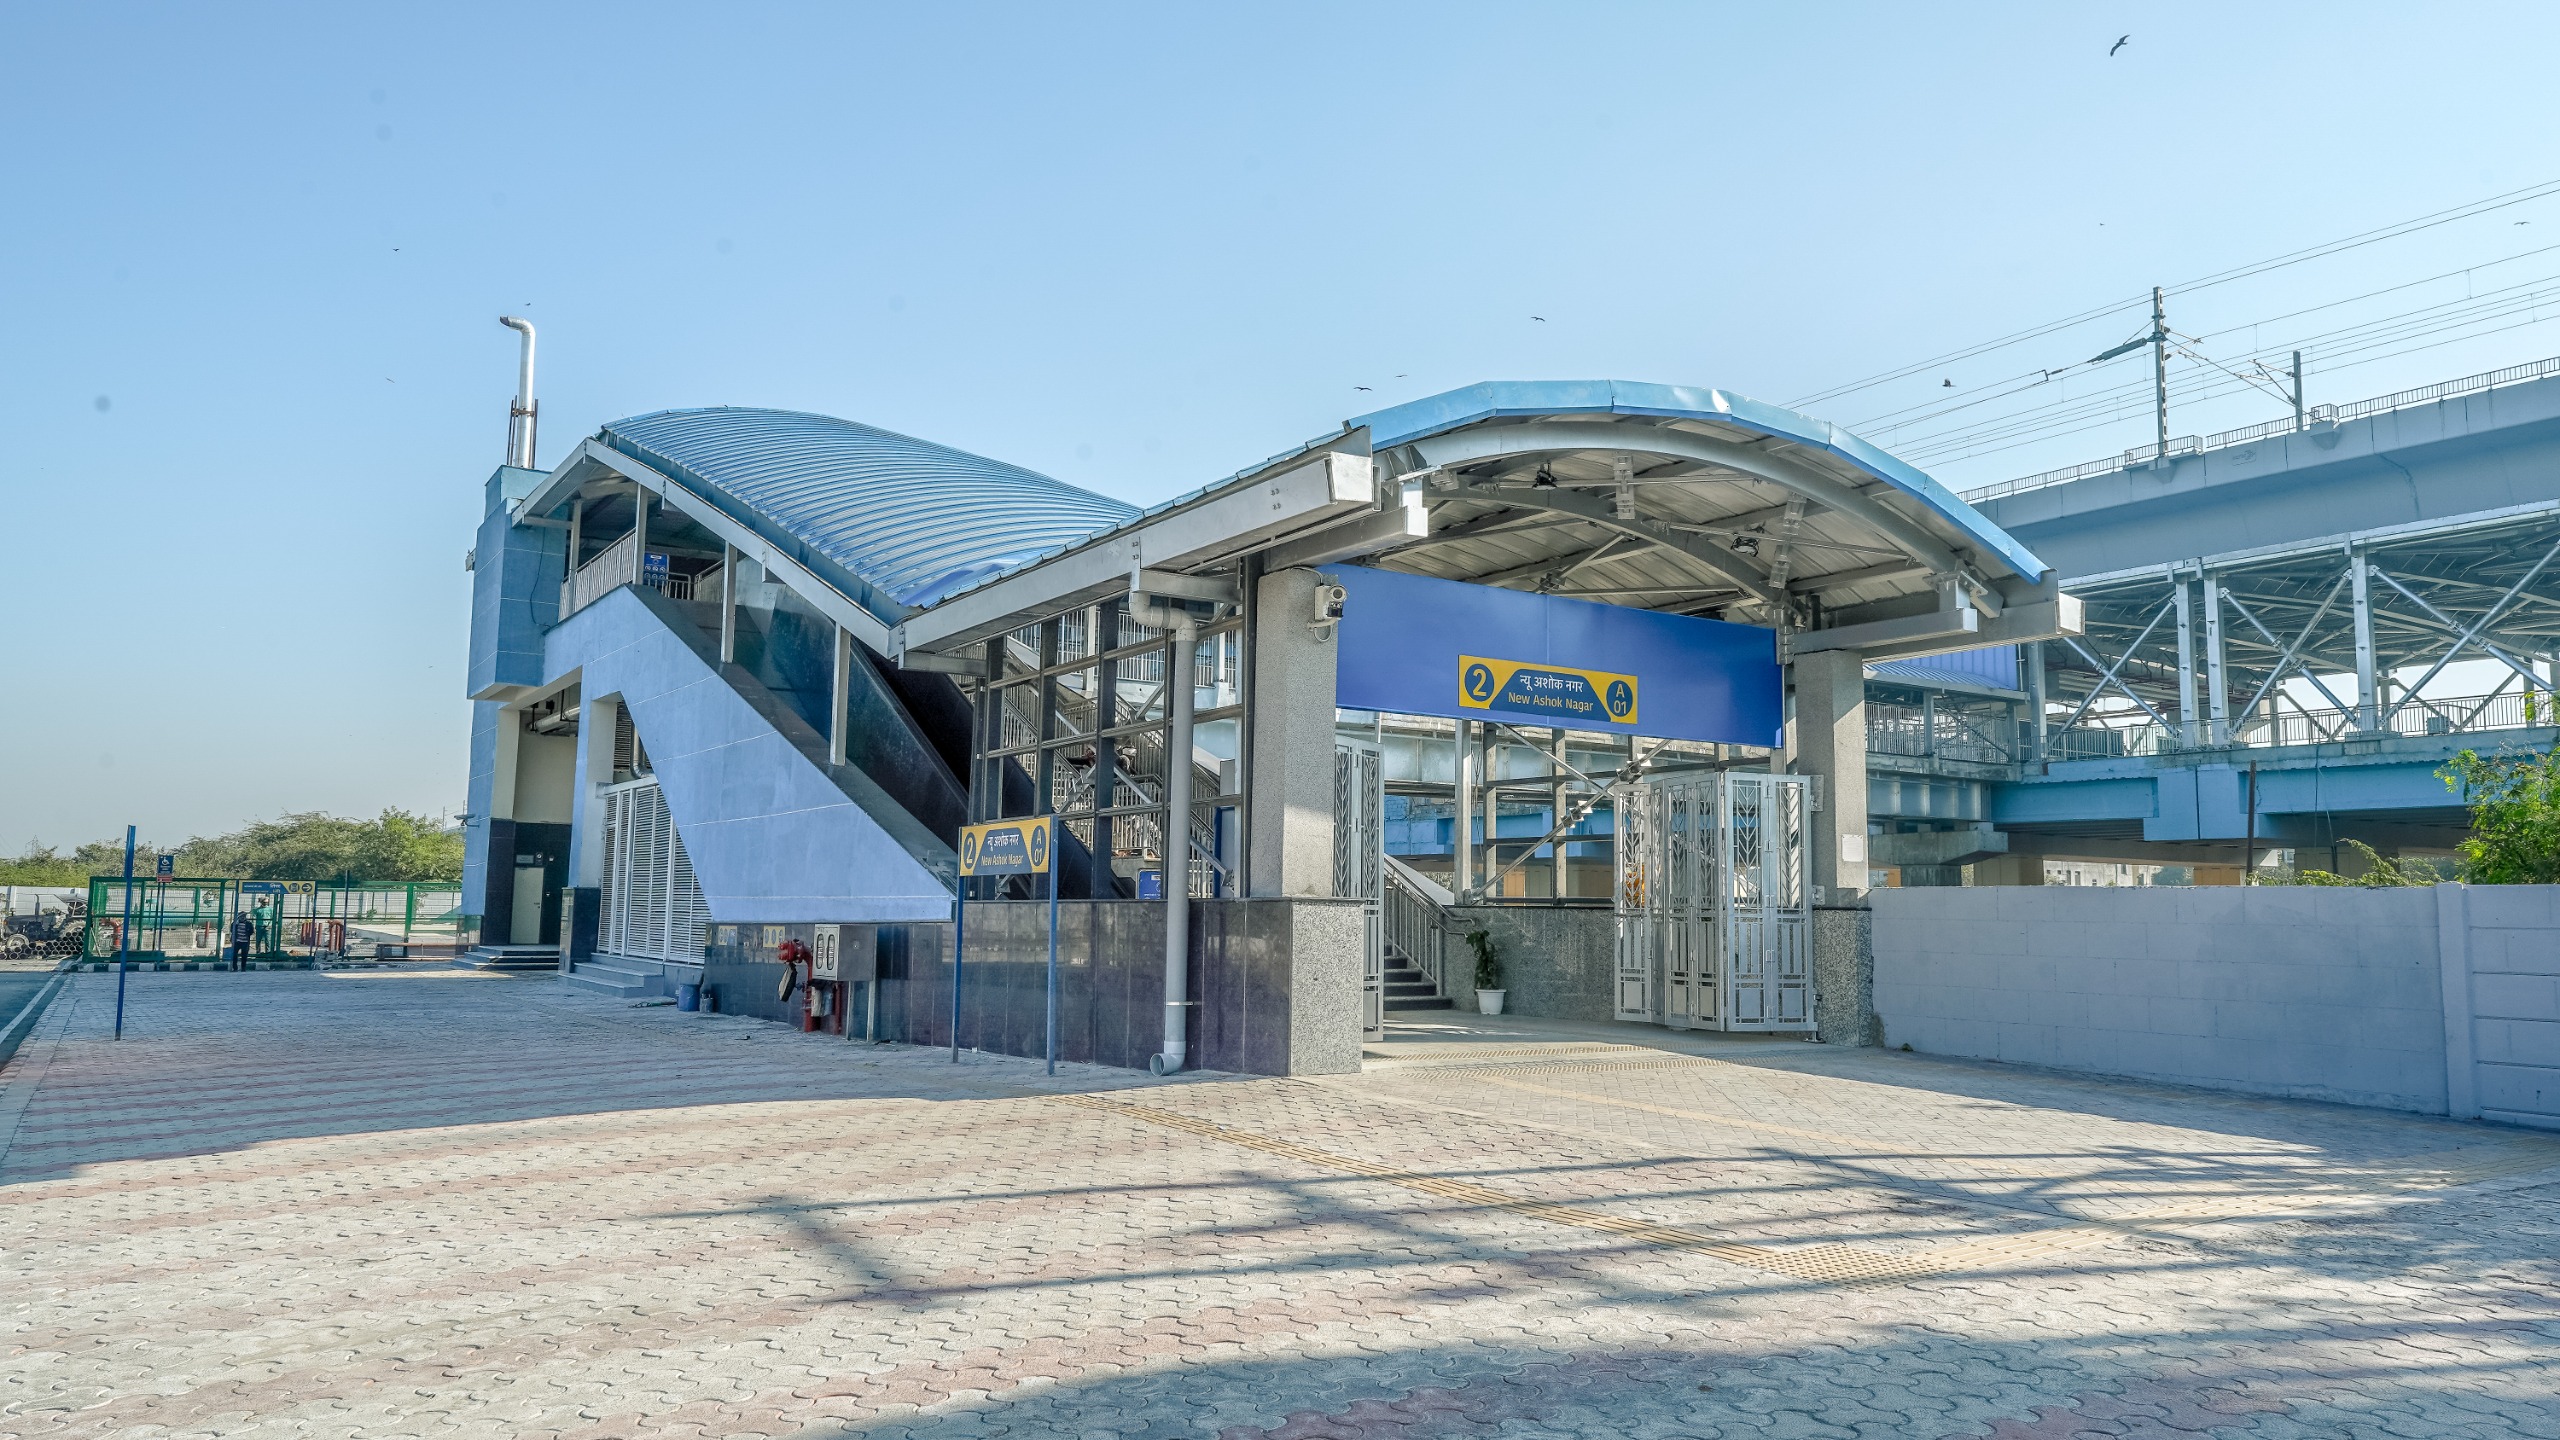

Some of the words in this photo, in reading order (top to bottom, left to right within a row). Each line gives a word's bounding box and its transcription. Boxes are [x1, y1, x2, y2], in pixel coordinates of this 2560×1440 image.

[1472, 668, 1487, 697] 2
[1520, 674, 1533, 691] न्यू
[1533, 674, 1563, 690] अशोक
[1565, 680, 1584, 692] नगर
[1615, 683, 1625, 698] A
[1508, 691, 1530, 705] New
[1533, 694, 1563, 708] Ashok
[1566, 698, 1593, 713] Nagar
[1613, 701, 1627, 715] 01
[1036, 829, 1042, 845] A
[966, 837, 973, 864] 2
[1034, 848, 1043, 863] 01
[981, 855, 992, 867] New
[992, 853, 1008, 866] Ashok
[1008, 853, 1024, 868] Nagar
